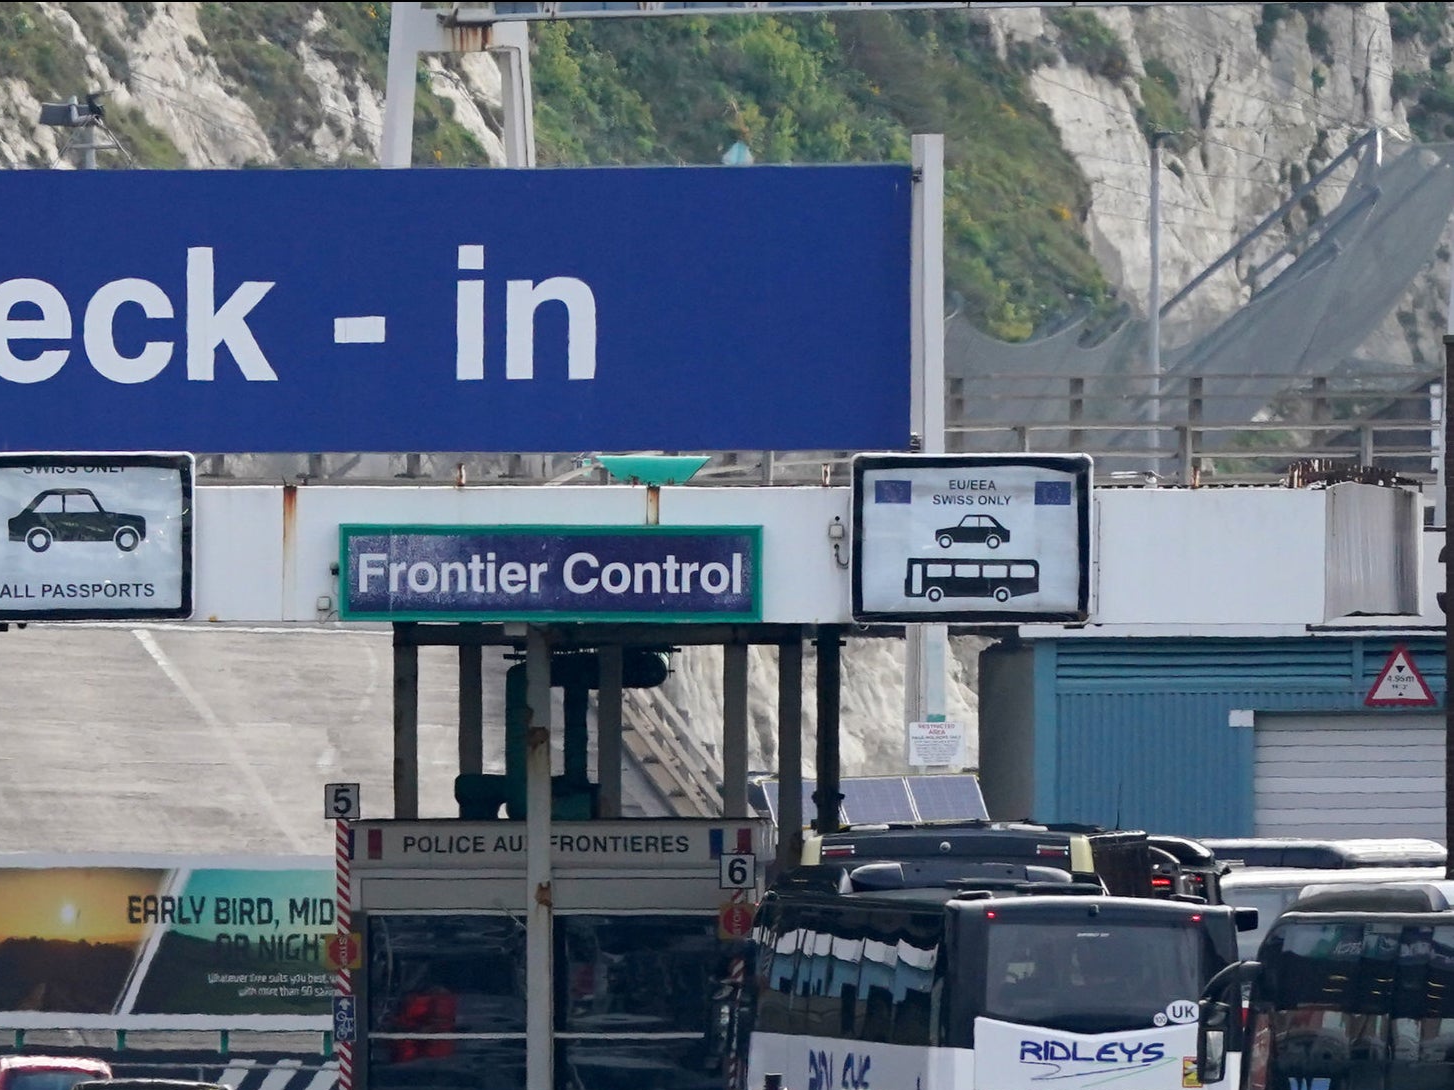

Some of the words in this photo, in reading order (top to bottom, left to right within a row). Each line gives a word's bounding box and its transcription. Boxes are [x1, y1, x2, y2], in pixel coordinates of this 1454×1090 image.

[455, 244, 597, 381] in
[949, 480, 997, 490] EU/EEA
[932, 495, 974, 505] SWISS
[977, 495, 1011, 505] ONLY
[358, 552, 547, 595] Frontier
[562, 552, 742, 595] Control
[0, 584, 35, 598] ALL
[41, 583, 155, 598] PASSPORTS
[333, 787, 352, 815] 5
[403, 835, 485, 853] POLICE
[492, 835, 528, 853] AU
[550, 835, 690, 853] FRONTIERES
[728, 858, 747, 884] 6
[127, 895, 206, 925] EARLY
[214, 897, 280, 929] BIRD,
[279, 986, 300, 997] than
[1172, 1005, 1195, 1018] UK
[1019, 1040, 1165, 1063] RIDLEYS
